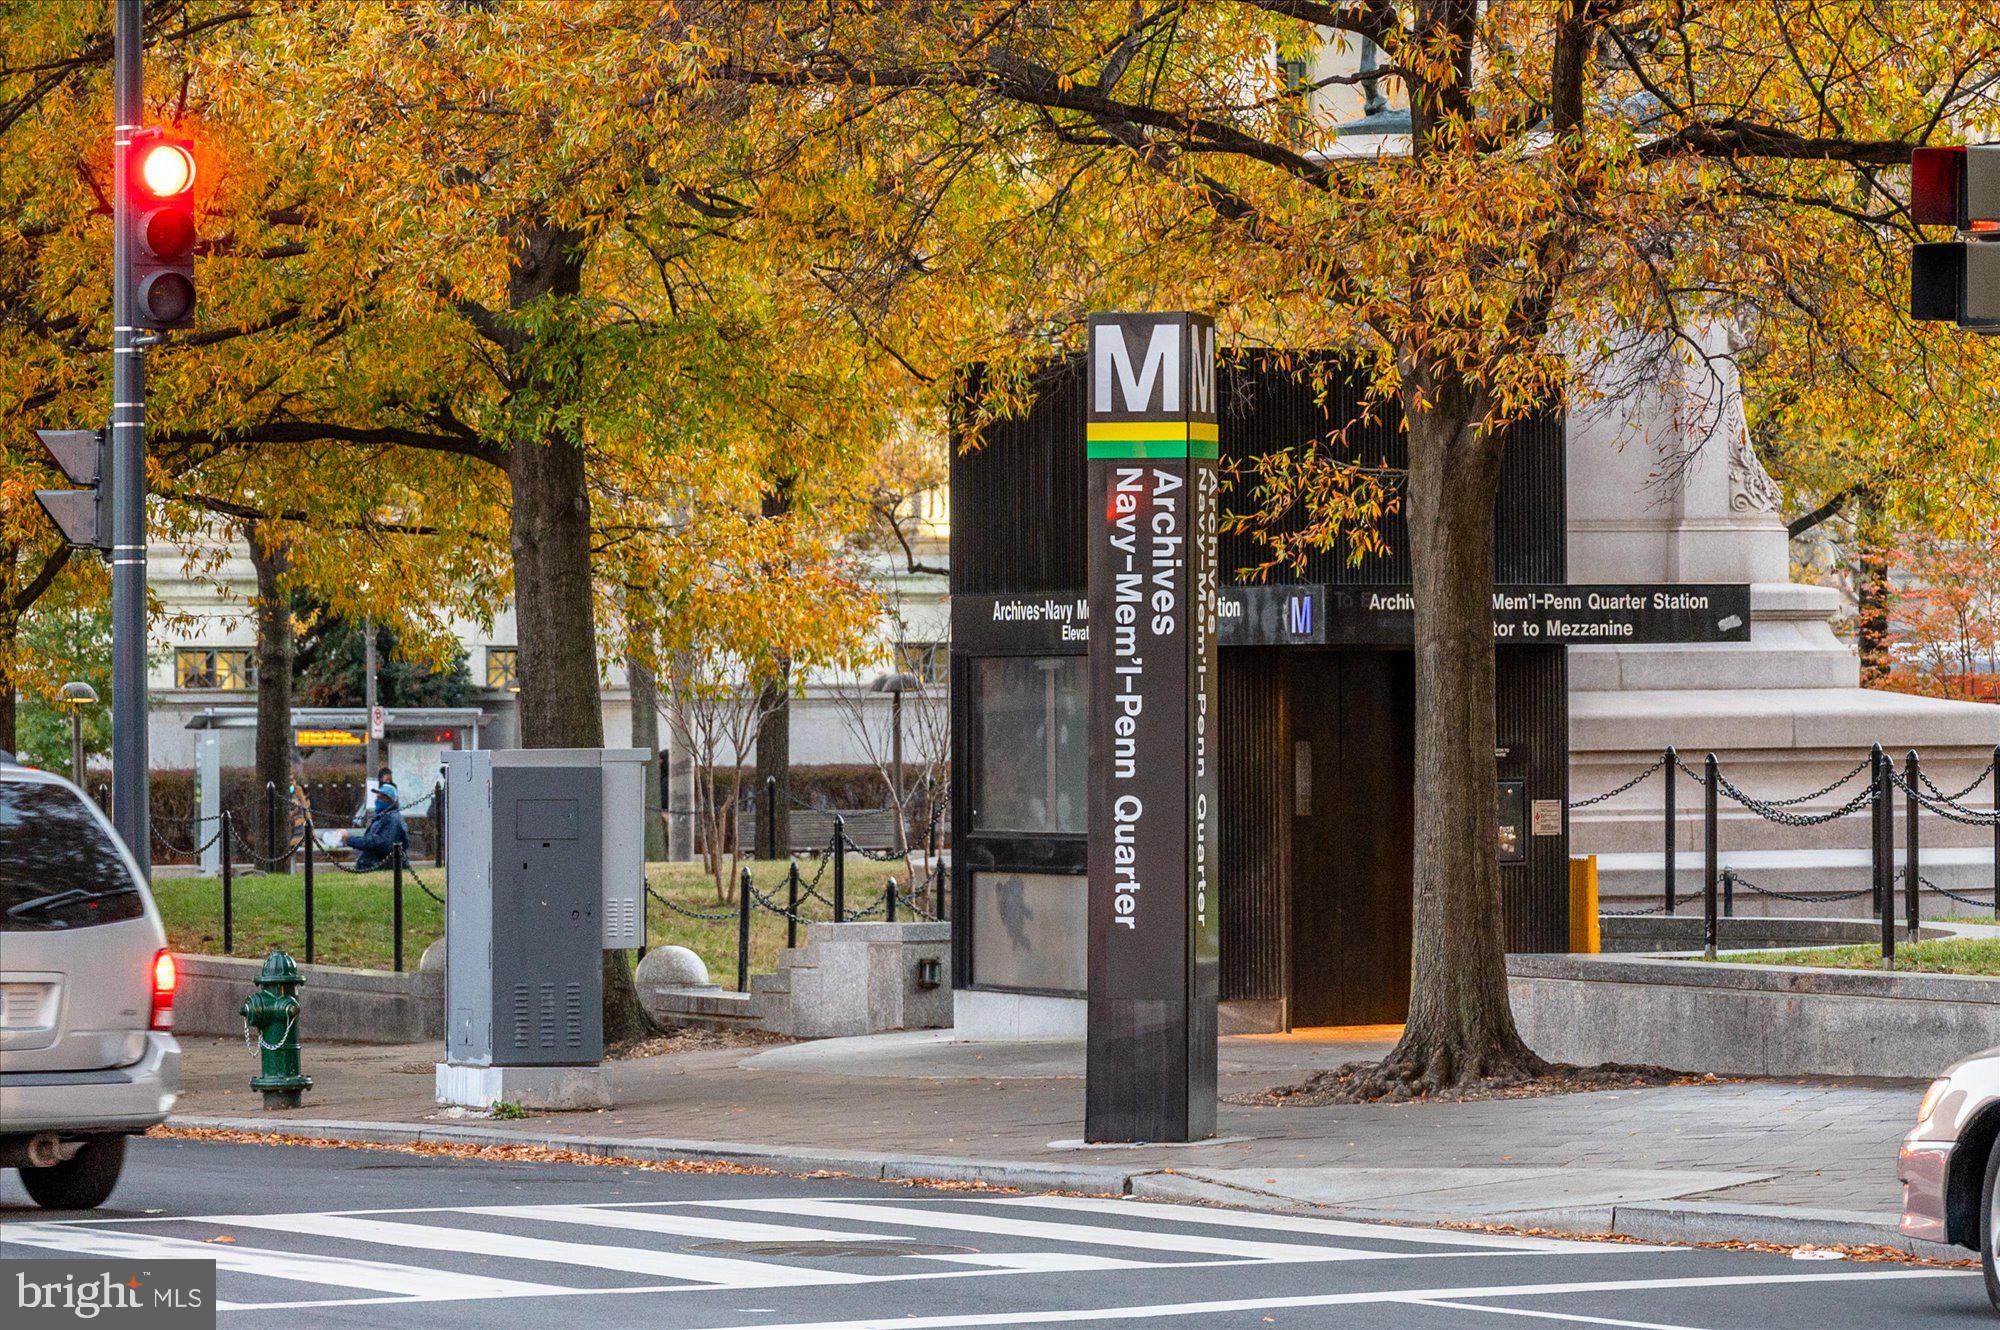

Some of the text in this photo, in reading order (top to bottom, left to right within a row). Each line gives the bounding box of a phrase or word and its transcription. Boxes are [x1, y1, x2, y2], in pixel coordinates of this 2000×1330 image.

[1095, 324, 1180, 412] M
[1191, 324, 1215, 413] M
[1151, 469, 1183, 635] Archives
[1208, 469, 1218, 635] Archives
[992, 599, 1074, 624] Archives-Navy
[1290, 596, 1311, 634] M
[1523, 621, 1539, 637] to
[1546, 619, 1634, 637] Mezzanine
[1588, 593, 1647, 611] Quarter
[1653, 593, 1709, 610] Station
[1114, 794, 1143, 930] Quarter
[1197, 793, 1207, 927] Quarter
